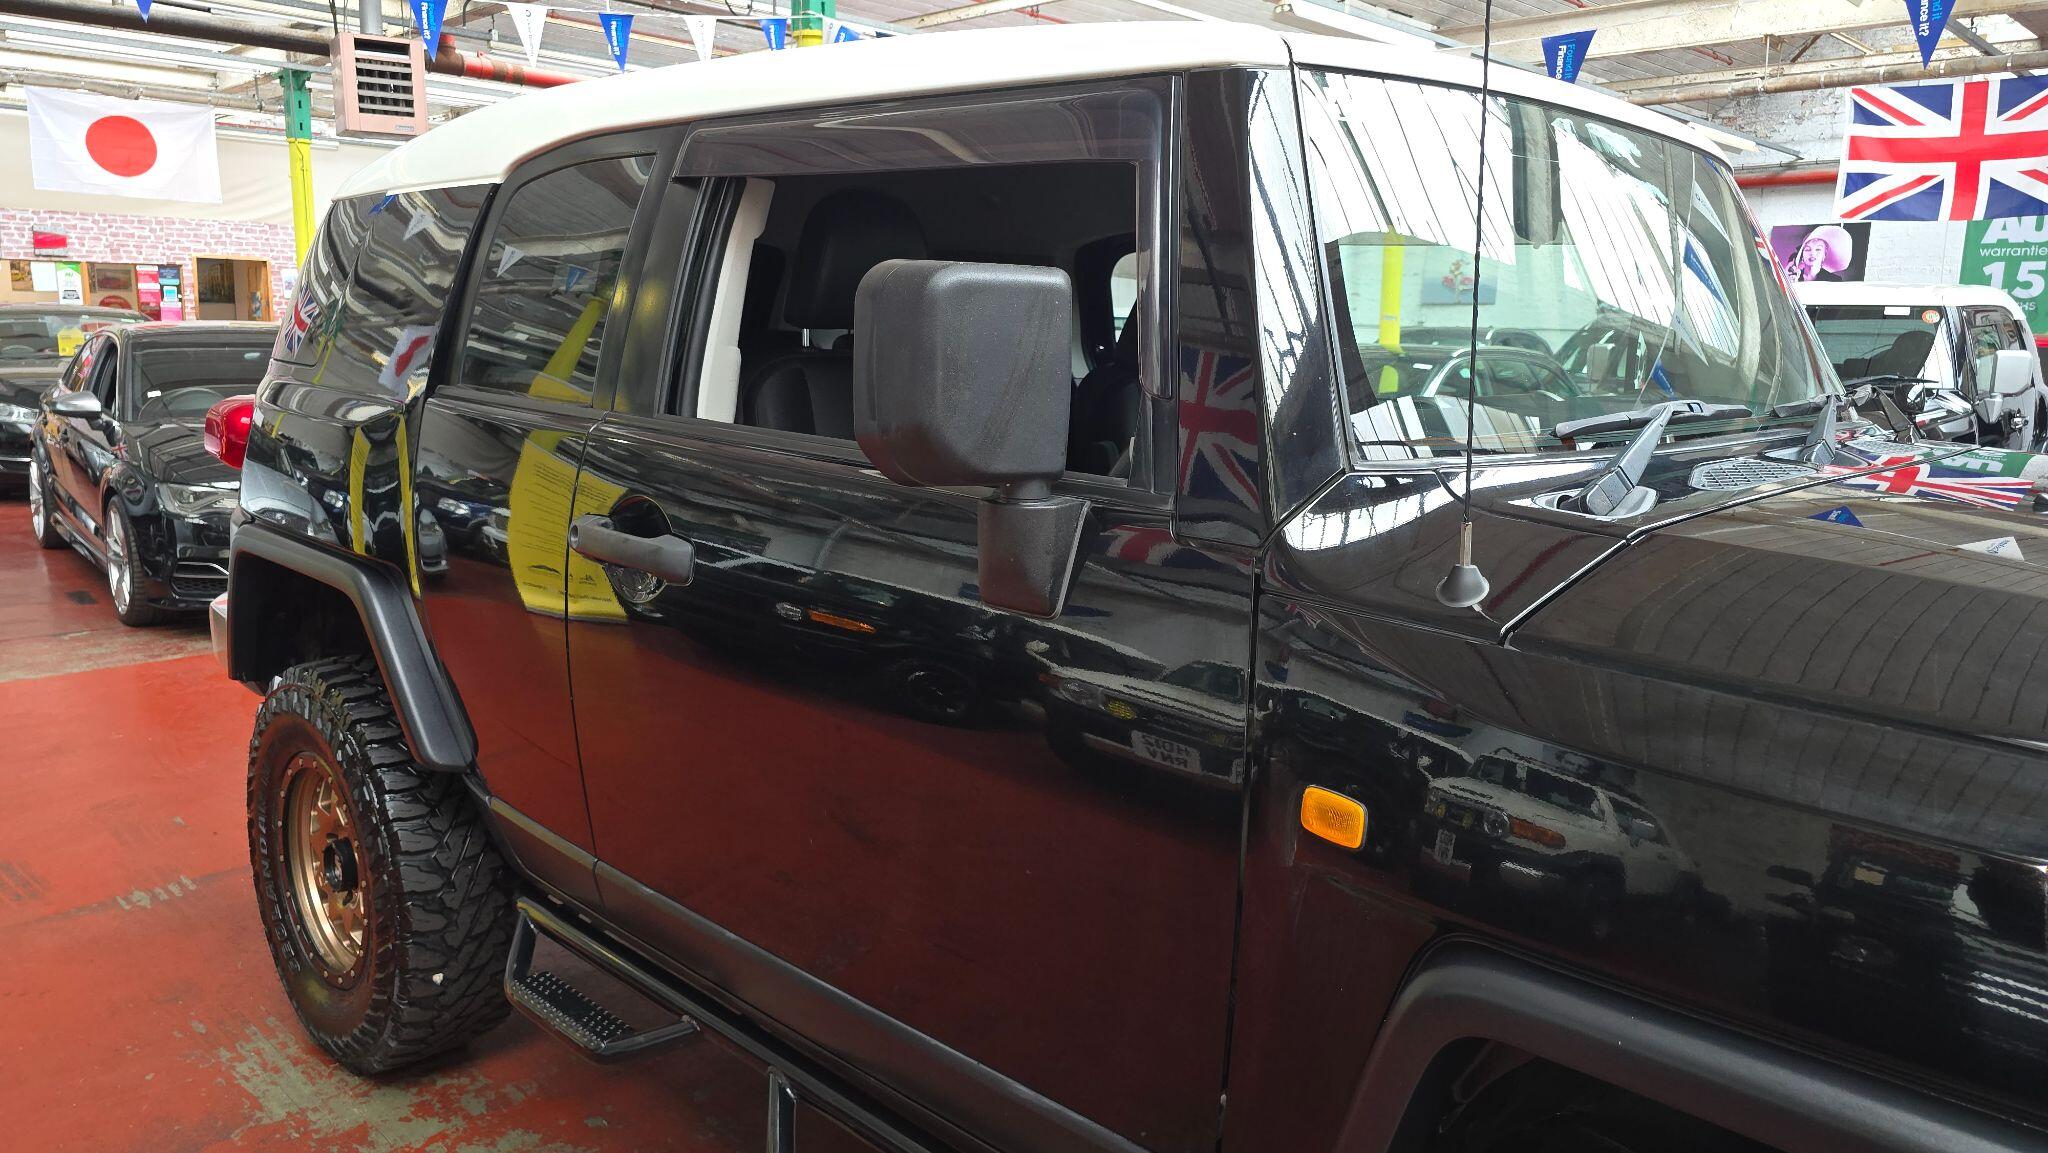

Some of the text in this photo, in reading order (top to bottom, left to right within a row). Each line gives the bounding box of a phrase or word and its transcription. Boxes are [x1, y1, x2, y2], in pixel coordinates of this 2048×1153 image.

[1919, 22, 1930, 36] it?
[1556, 45, 1567, 80] Finance
[1565, 44, 1576, 72] Found
[1983, 261, 2045, 299] 15
